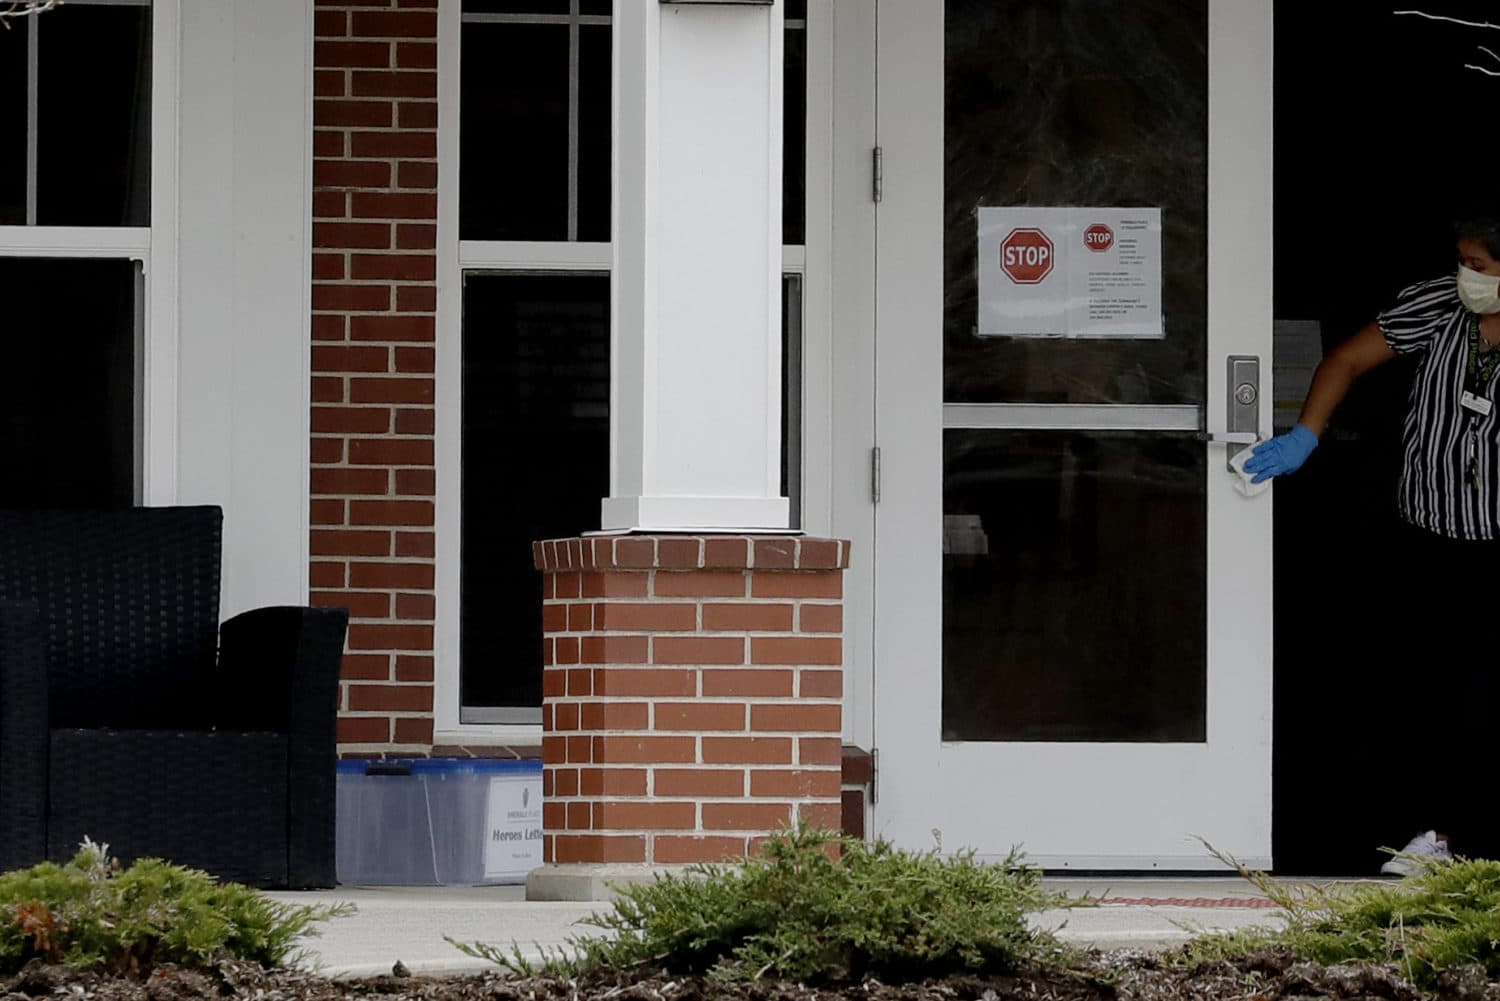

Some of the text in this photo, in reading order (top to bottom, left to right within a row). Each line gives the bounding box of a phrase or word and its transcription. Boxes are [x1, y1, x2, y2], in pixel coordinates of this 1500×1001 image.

[1087, 232, 1111, 244] STOP
[1005, 246, 1049, 266] STOP
[492, 828, 523, 841] Heroes
